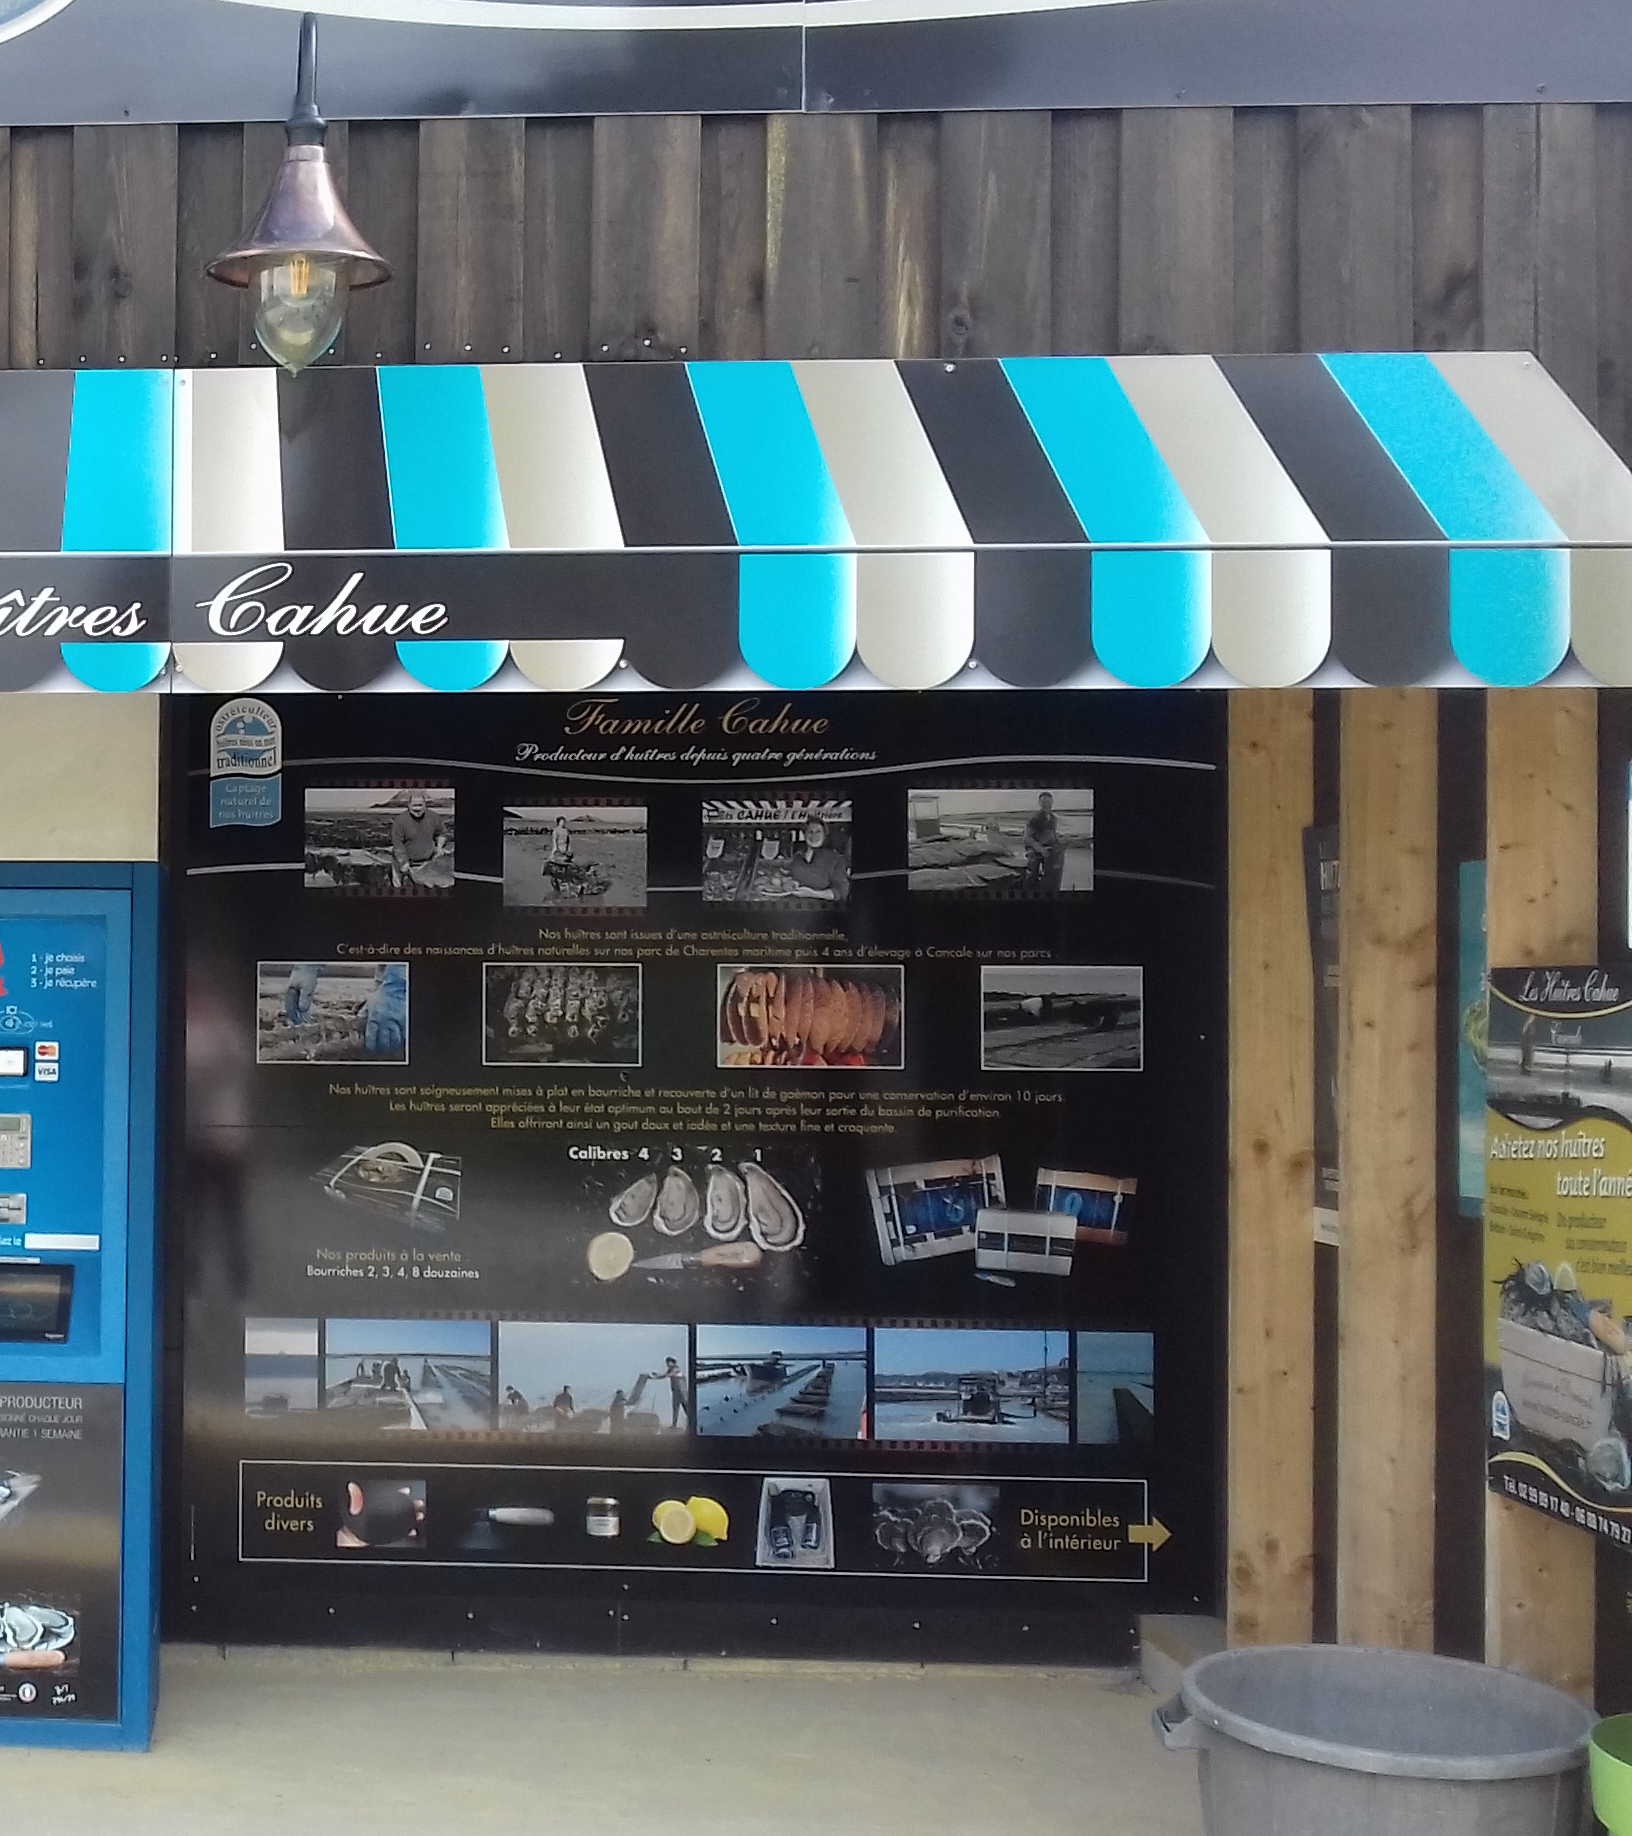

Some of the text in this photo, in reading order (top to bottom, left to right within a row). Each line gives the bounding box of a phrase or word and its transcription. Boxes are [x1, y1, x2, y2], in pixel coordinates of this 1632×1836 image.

[195, 562, 449, 637] Cahue
[564, 698, 829, 735] Famille Cahue
[217, 747, 277, 769] traditionnel
[515, 743, 878, 767] Producteur d'huîtres depuis quatre générations
[225, 783, 267, 796] Captage
[220, 796, 271, 806] naturel de
[218, 811, 236, 820] nos
[564, 928, 848, 941] huîtres sont issues d'une ostréiculture traditionnelle.
[31, 952, 85, 965] 1 je choisis
[336, 943, 1052, 961] C'est-à-dire naissances d'huîtres naturelles parc Charentes maritime puis d'élevage Cancale parcs
[30, 965, 75, 977] 2 je paie
[30, 977, 98, 989] 3 je récupère
[1519, 969, 1619, 1002] Les Huîtres Cahue
[38, 1068, 56, 1076] VISA
[354, 1083, 1066, 1104] huîtres sont soigneusement mises plat bourriche recouverte d'un goémon pour conservation d'environ jours.
[409, 1100, 1003, 1120] huîtres seront appréciées leur état optimum bout jours après leur sortie bassin purification.
[490, 1117, 898, 1136] Elles offriront ainsi gout doux iodée texture fine croquante.
[569, 1145, 762, 1161] Calibres 4 3 2 1
[1536, 1139, 1558, 1160] nos
[1561, 1131, 1606, 1160] huîtres
[1556, 1168, 1591, 1197] toute
[316, 1249, 462, 1264] Nos produits à la vente
[306, 1265, 480, 1280] Bourriches 2, 3, 4, 8 douzaines
[0, 1396, 83, 1410] PRODUCTEUR
[41, 1429, 83, 1440] SEMAINE
[256, 1491, 323, 1509] Produits
[264, 1515, 314, 1532] divers
[1020, 1508, 1121, 1530] Disponibles
[1020, 1532, 1122, 1551] à l'intérieur
